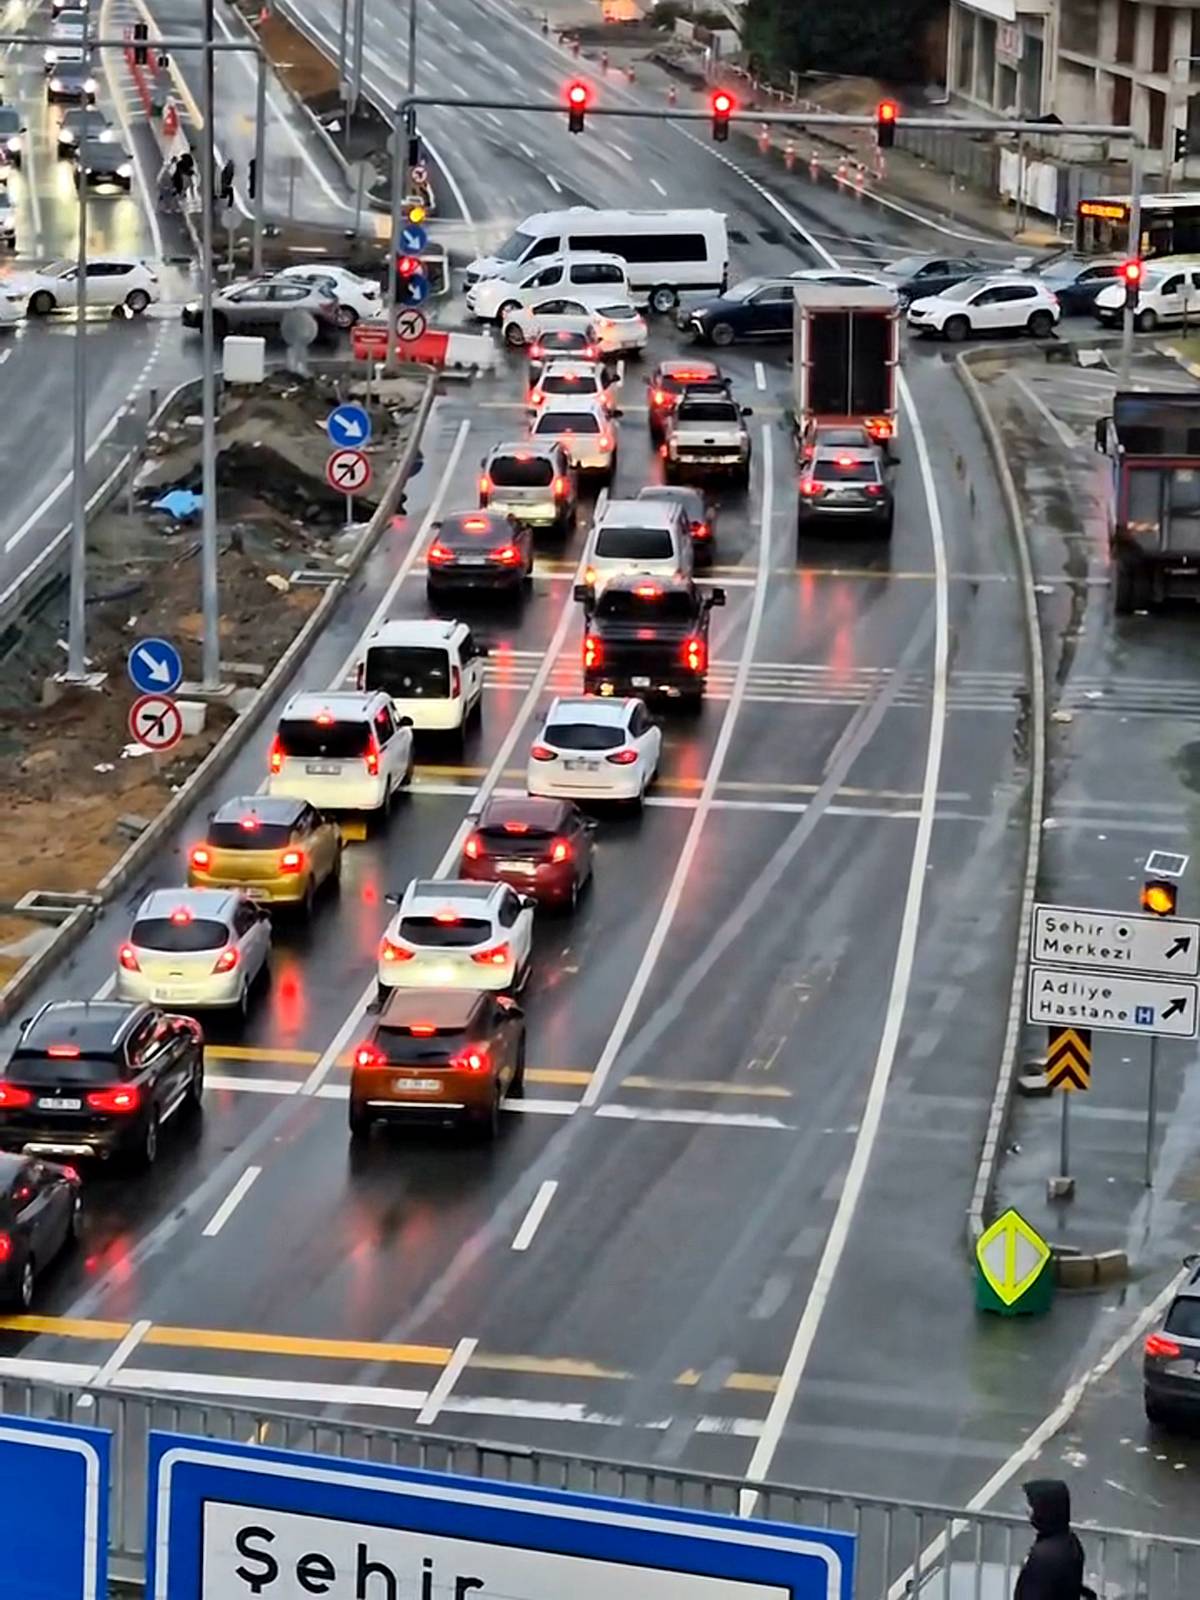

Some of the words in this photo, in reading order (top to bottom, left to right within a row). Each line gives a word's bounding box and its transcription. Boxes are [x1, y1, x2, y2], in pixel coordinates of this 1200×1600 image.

[1043, 938, 1132, 960] Merkezi
[1041, 979, 1112, 1000] Adliye
[1040, 1000, 1128, 1020] Hastane
[235, 1525, 485, 1600] Şehir
